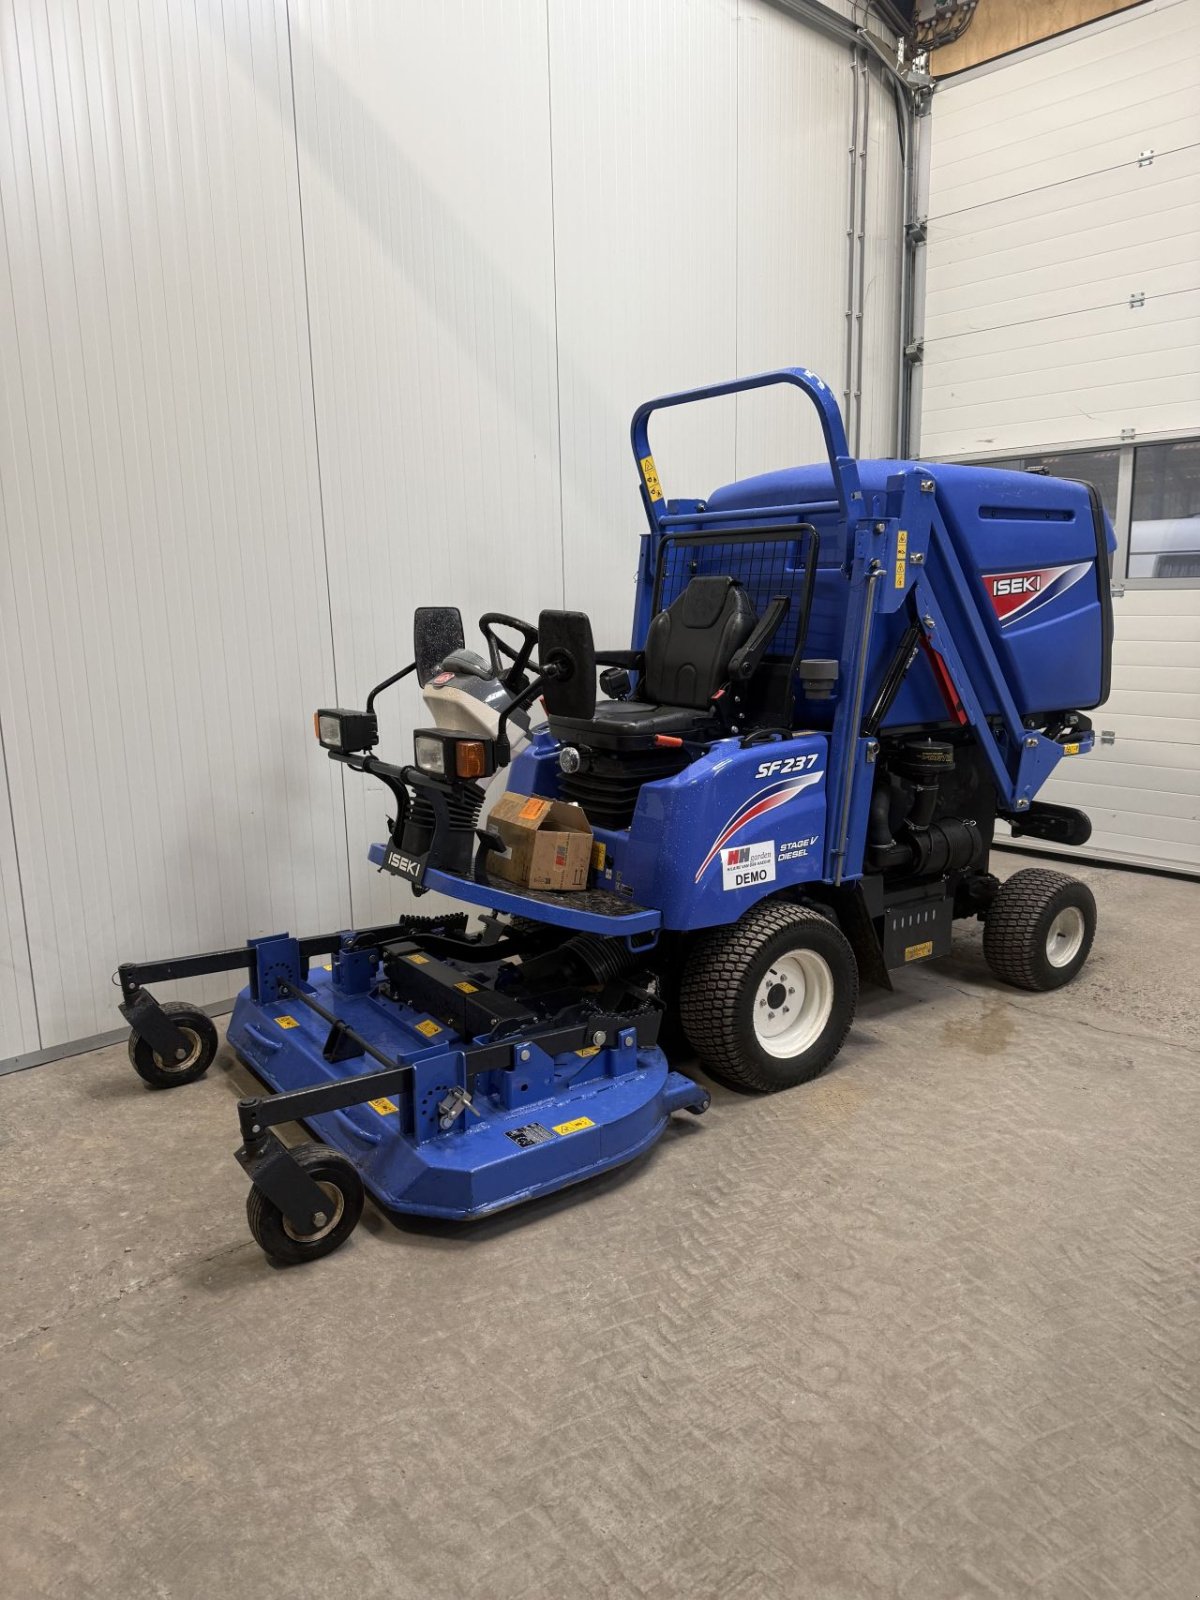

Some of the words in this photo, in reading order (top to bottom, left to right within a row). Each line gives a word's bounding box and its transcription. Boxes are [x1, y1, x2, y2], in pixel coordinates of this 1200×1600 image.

[993, 575, 1041, 596] ISEKI
[755, 753, 819, 778] SF237
[780, 839, 810, 851] STAGE
[810, 835, 819, 845] V
[388, 851, 421, 877] ISEKI
[777, 849, 808, 861] DIESEL
[735, 869, 767, 886] DEMO
